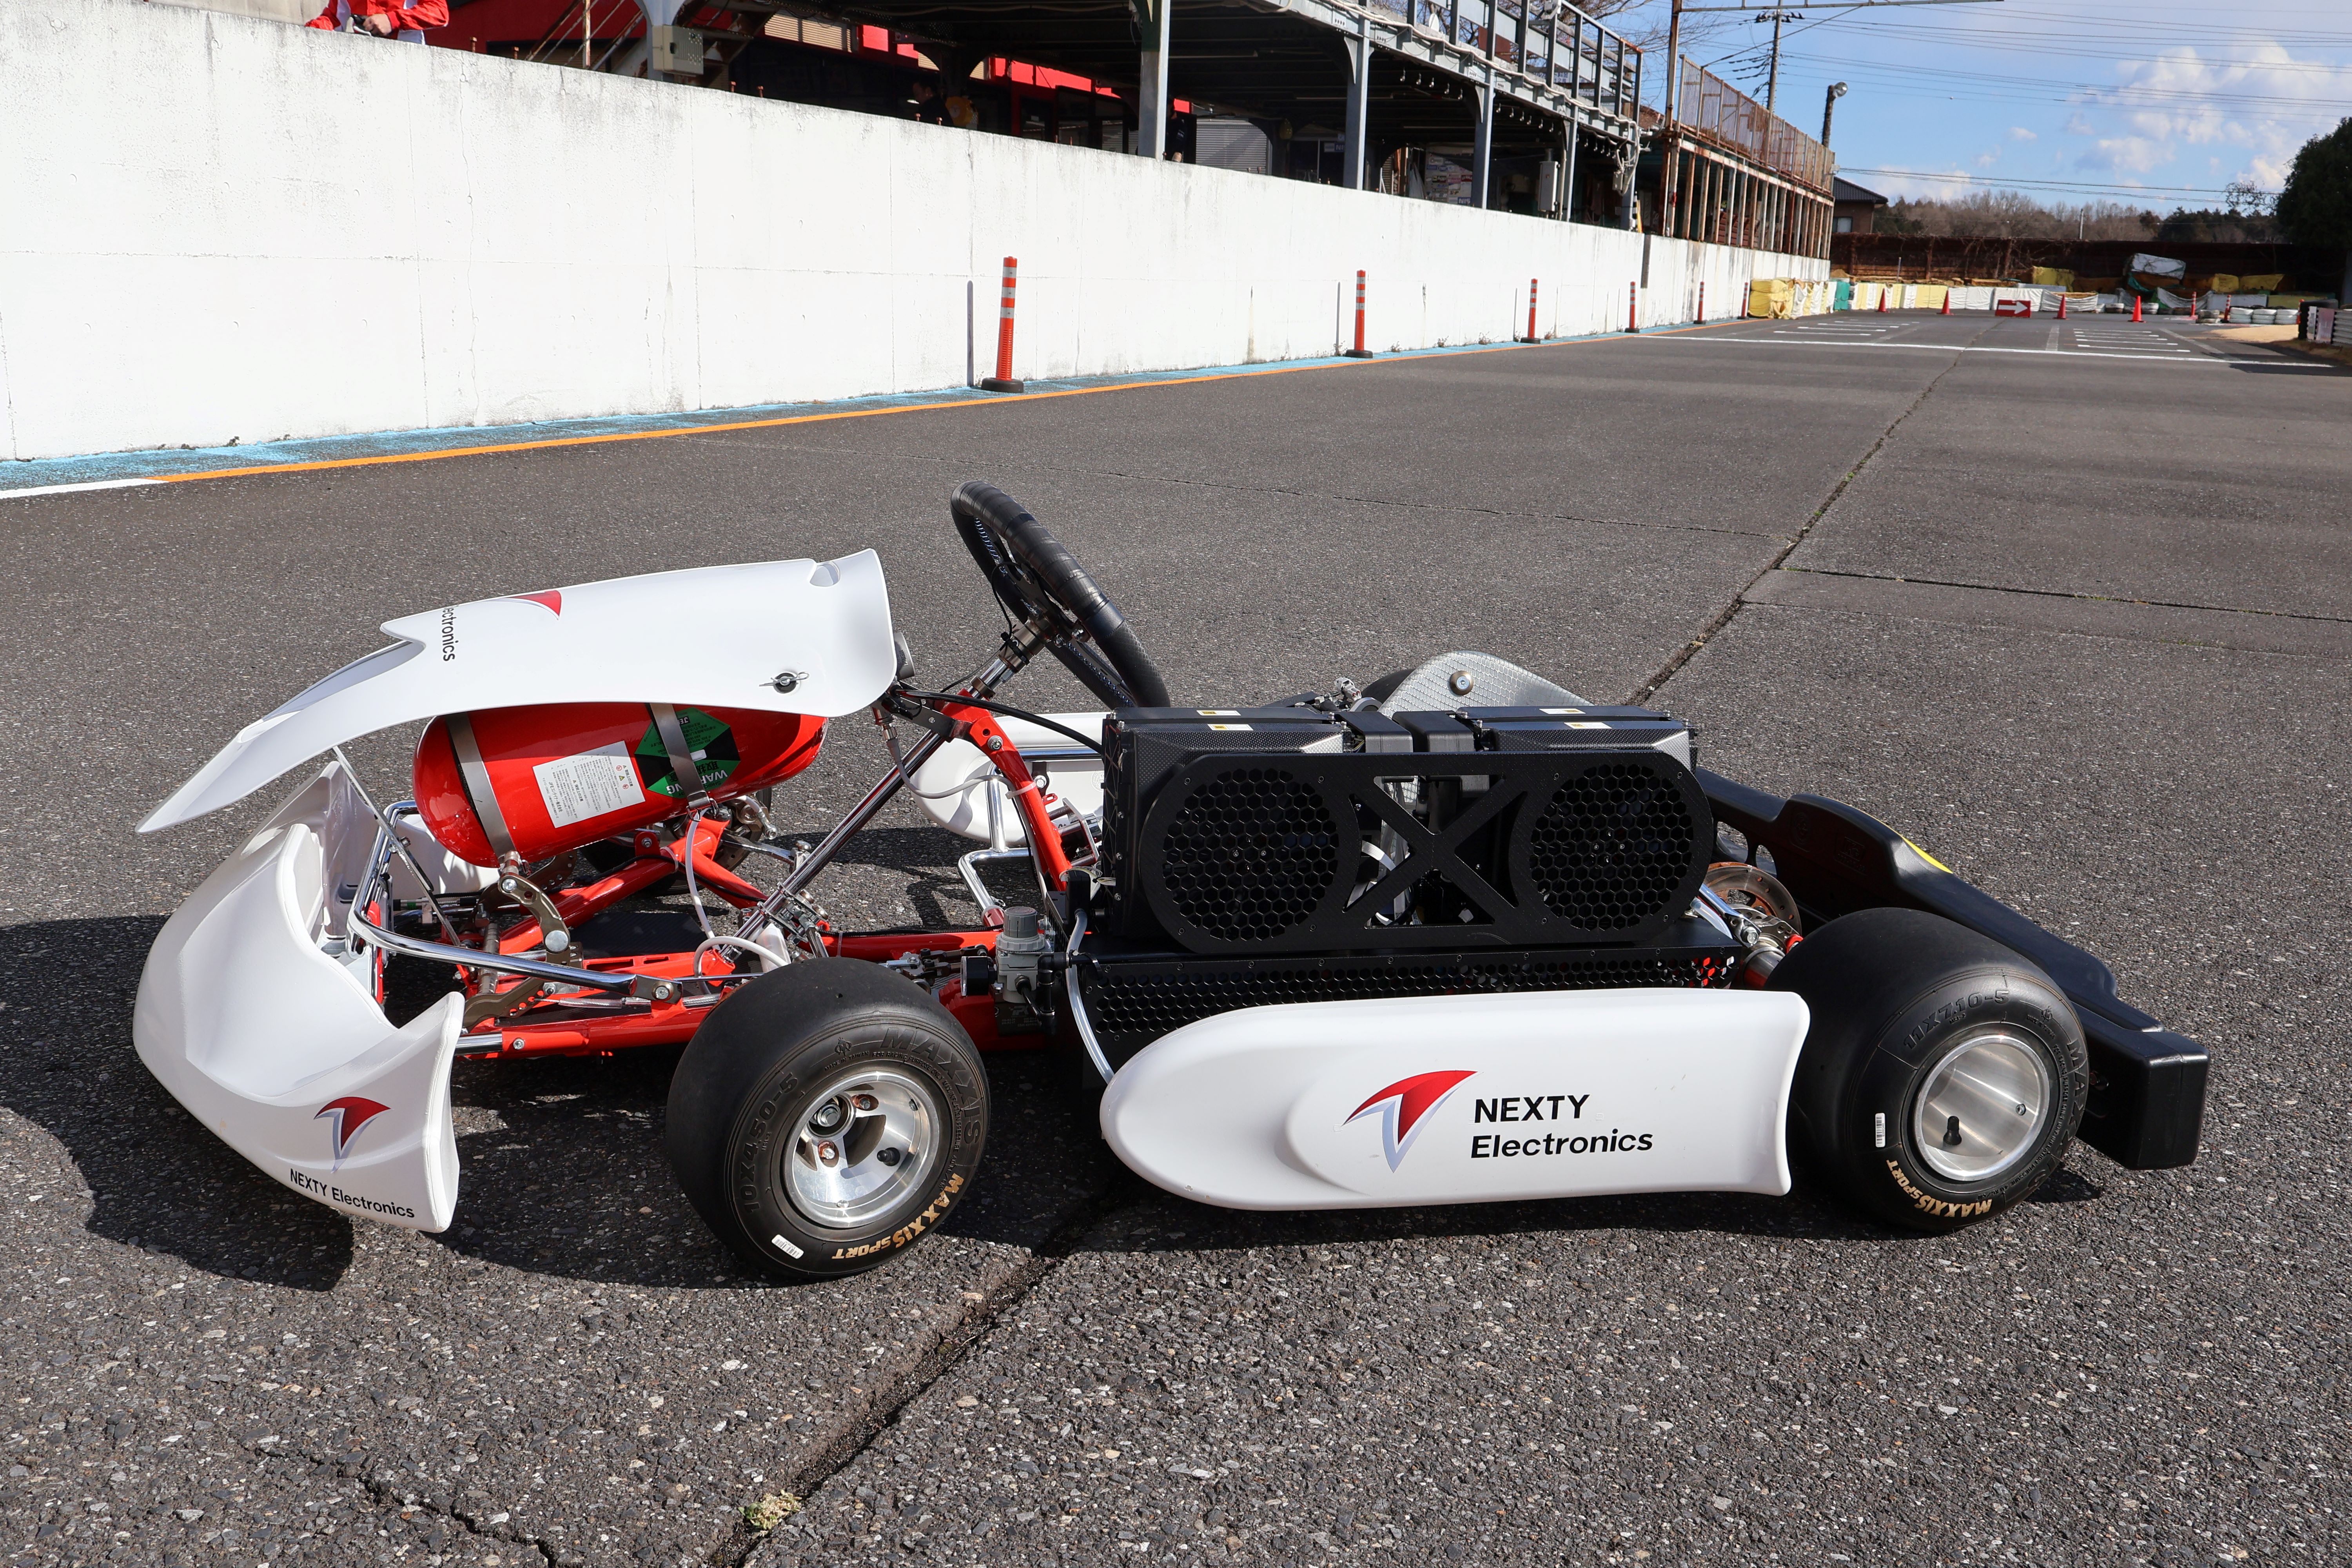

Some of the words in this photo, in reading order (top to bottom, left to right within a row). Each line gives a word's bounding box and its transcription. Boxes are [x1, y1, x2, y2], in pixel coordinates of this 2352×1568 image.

[442, 606, 459, 661] ectronics
[1904, 990, 2009, 1049] 11X7.10-5
[824, 1060, 840, 1071] MADE
[909, 1056, 933, 1071] PURPOSE
[931, 1068, 944, 1081] ONLY
[880, 1027, 981, 1144] MAXXIS
[1474, 1094, 1590, 1123] NEXTY
[740, 1072, 798, 1213] 10X4.50-5
[1471, 1129, 1653, 1158] Electronics
[290, 1168, 327, 1196] NEXTY
[332, 1187, 414, 1218] Electronics
[1886, 1159, 1923, 1200] SPORT
[893, 1173, 964, 1248] MAXXIS
[1914, 1195, 1993, 1217] MAXXIS
[832, 1236, 891, 1259] SPORT
